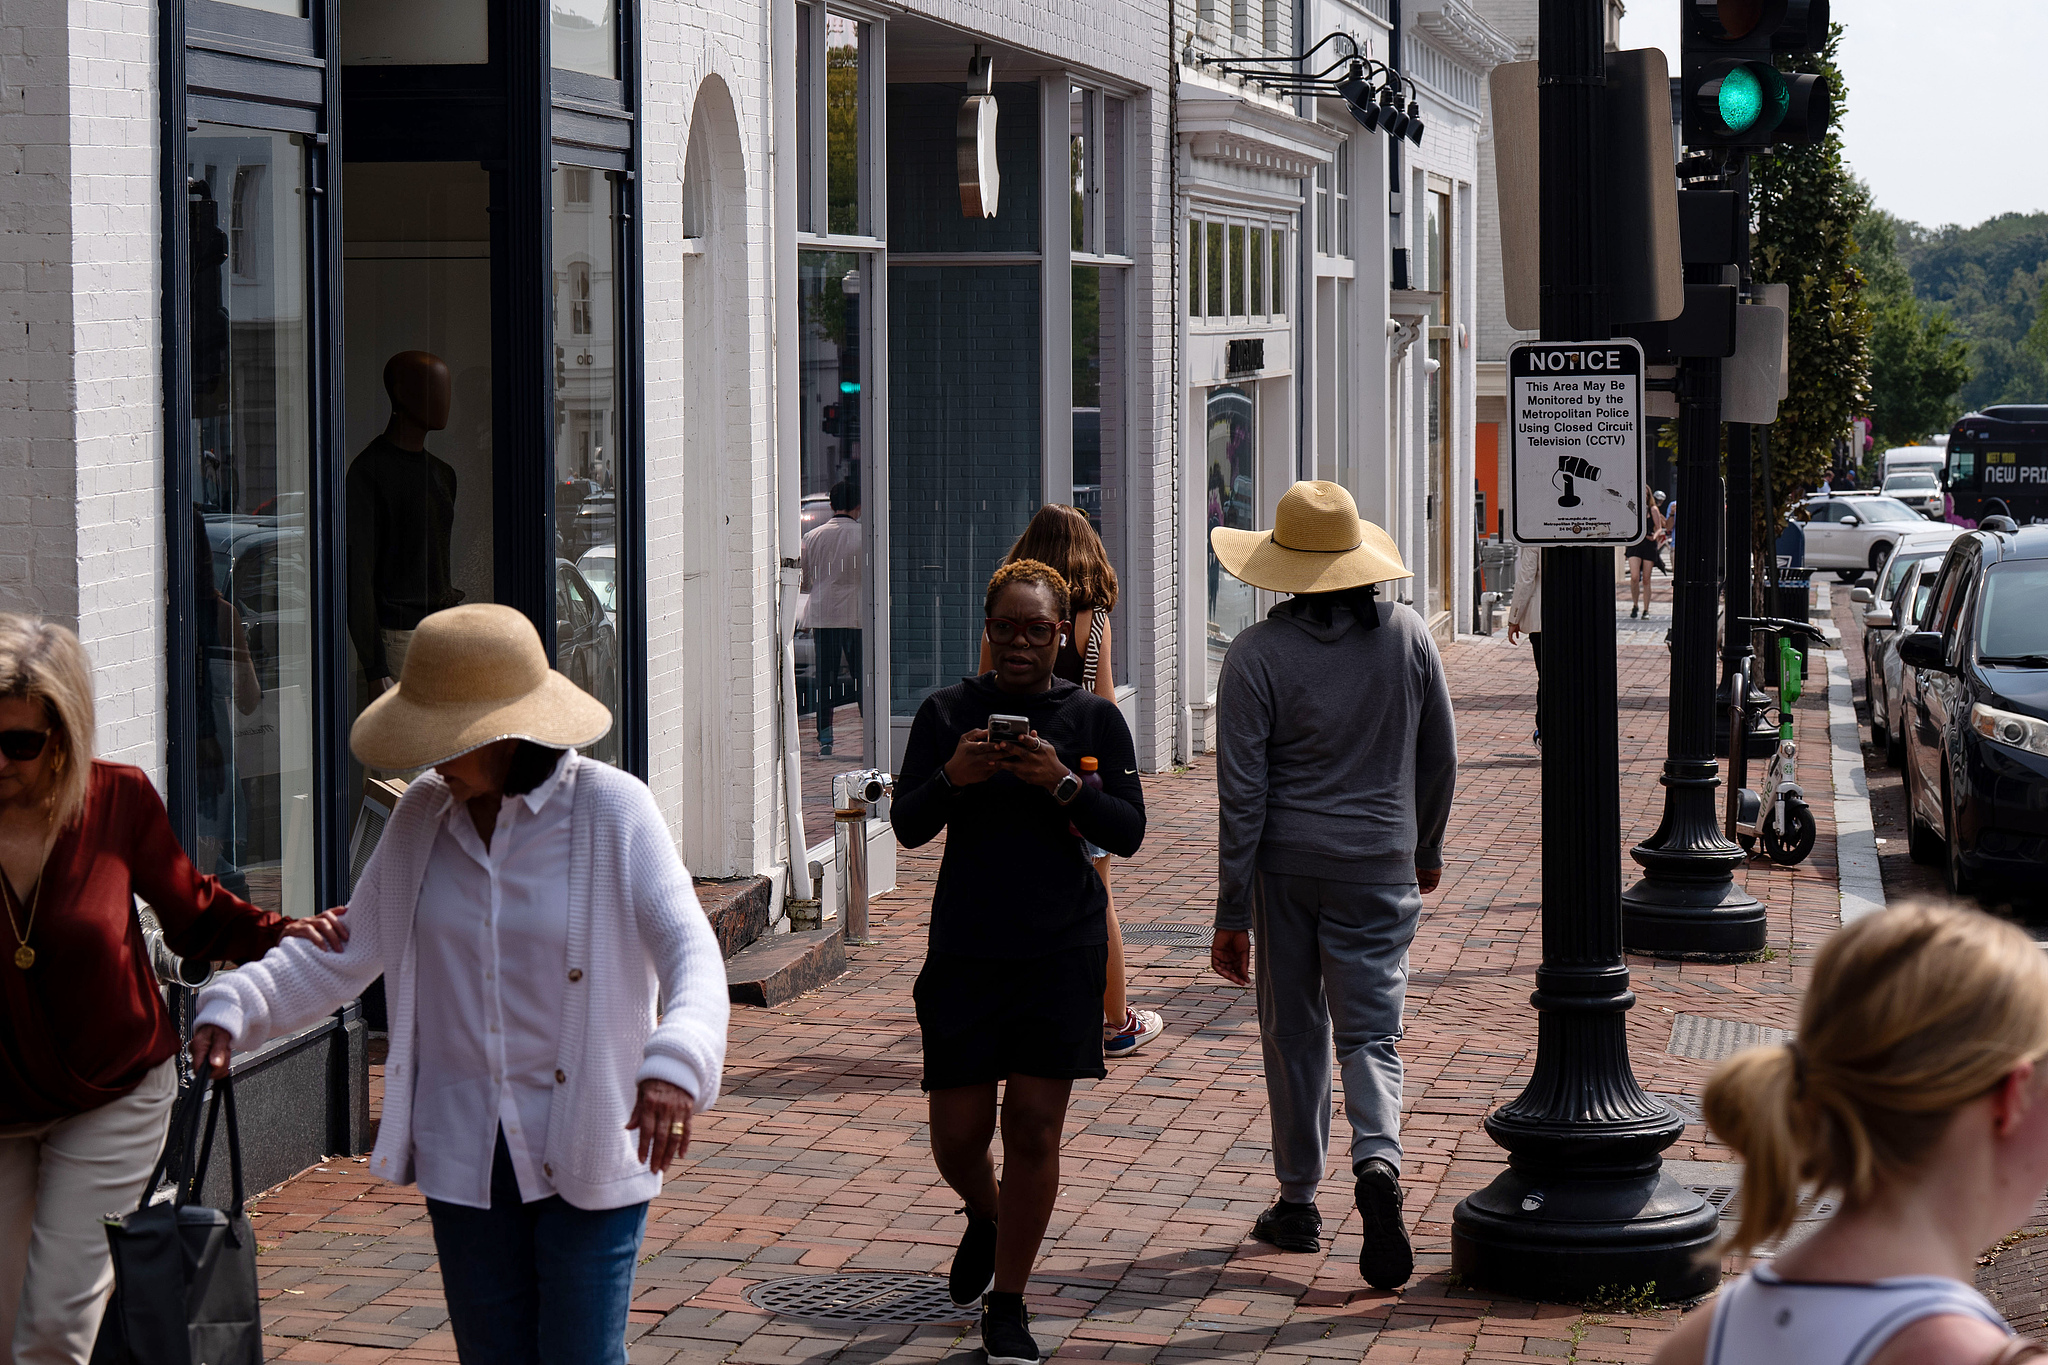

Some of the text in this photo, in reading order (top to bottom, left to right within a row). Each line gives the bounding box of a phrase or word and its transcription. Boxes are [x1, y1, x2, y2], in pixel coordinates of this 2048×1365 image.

[1529, 351, 1621, 371] NOTICE
[1526, 380, 1625, 392] This Area May Be
[1527, 394, 1624, 406] Monitored by the
[1522, 408, 1630, 420] Metropolitan Police
[1519, 421, 1634, 434] Using Closed Circuit
[1527, 435, 1625, 447] Television (CCTV)
[1985, 466, 2048, 483] NEW PRI
